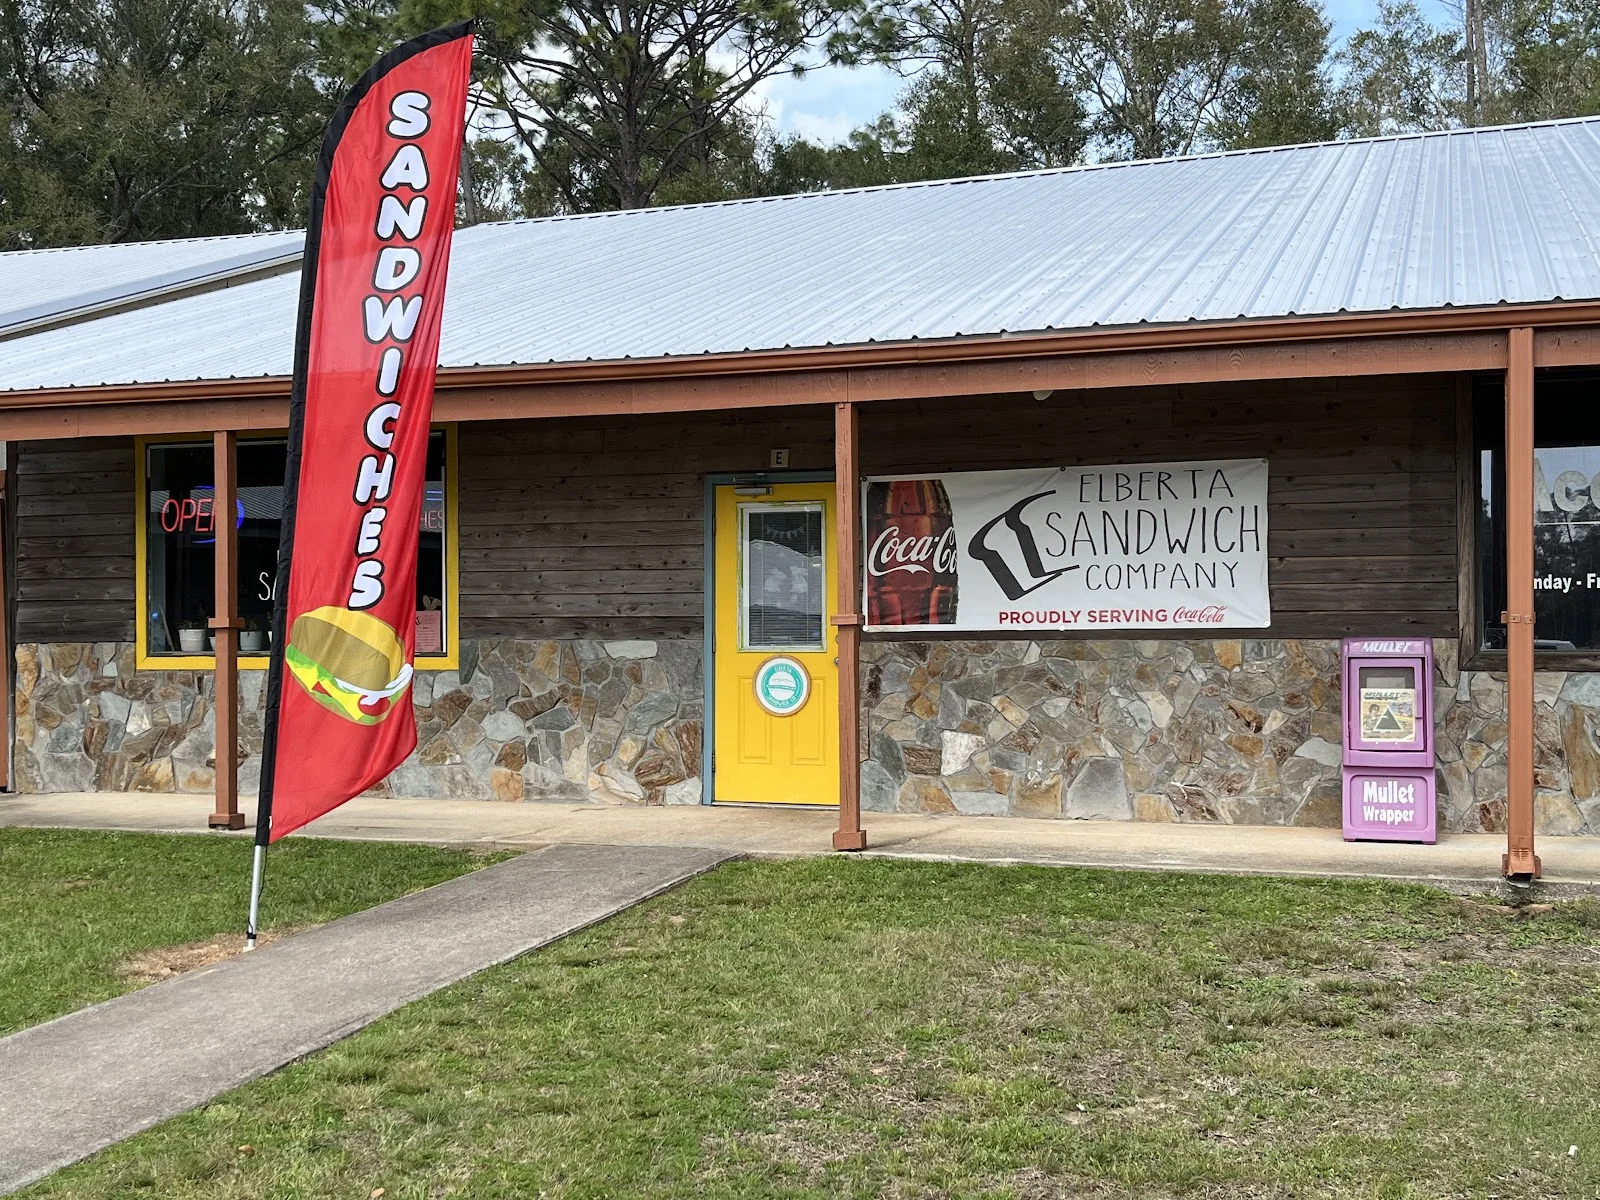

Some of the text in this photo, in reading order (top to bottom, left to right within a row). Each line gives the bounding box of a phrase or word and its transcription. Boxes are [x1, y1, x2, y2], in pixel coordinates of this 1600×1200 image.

[348, 91, 430, 611] SANDWICHES
[775, 451, 783, 465] E
[1079, 468, 1234, 503] ELBERTA
[1045, 505, 1260, 557] SANDWICH
[1085, 561, 1239, 590] COMPANY
[1534, 573, 1572, 593] nday
[999, 605, 1228, 625] PROUDLY SERVING Coca-Cola
[1361, 641, 1412, 652] MULLET
[1363, 780, 1415, 804] Mullet
[1363, 806, 1415, 826] Wrapper
